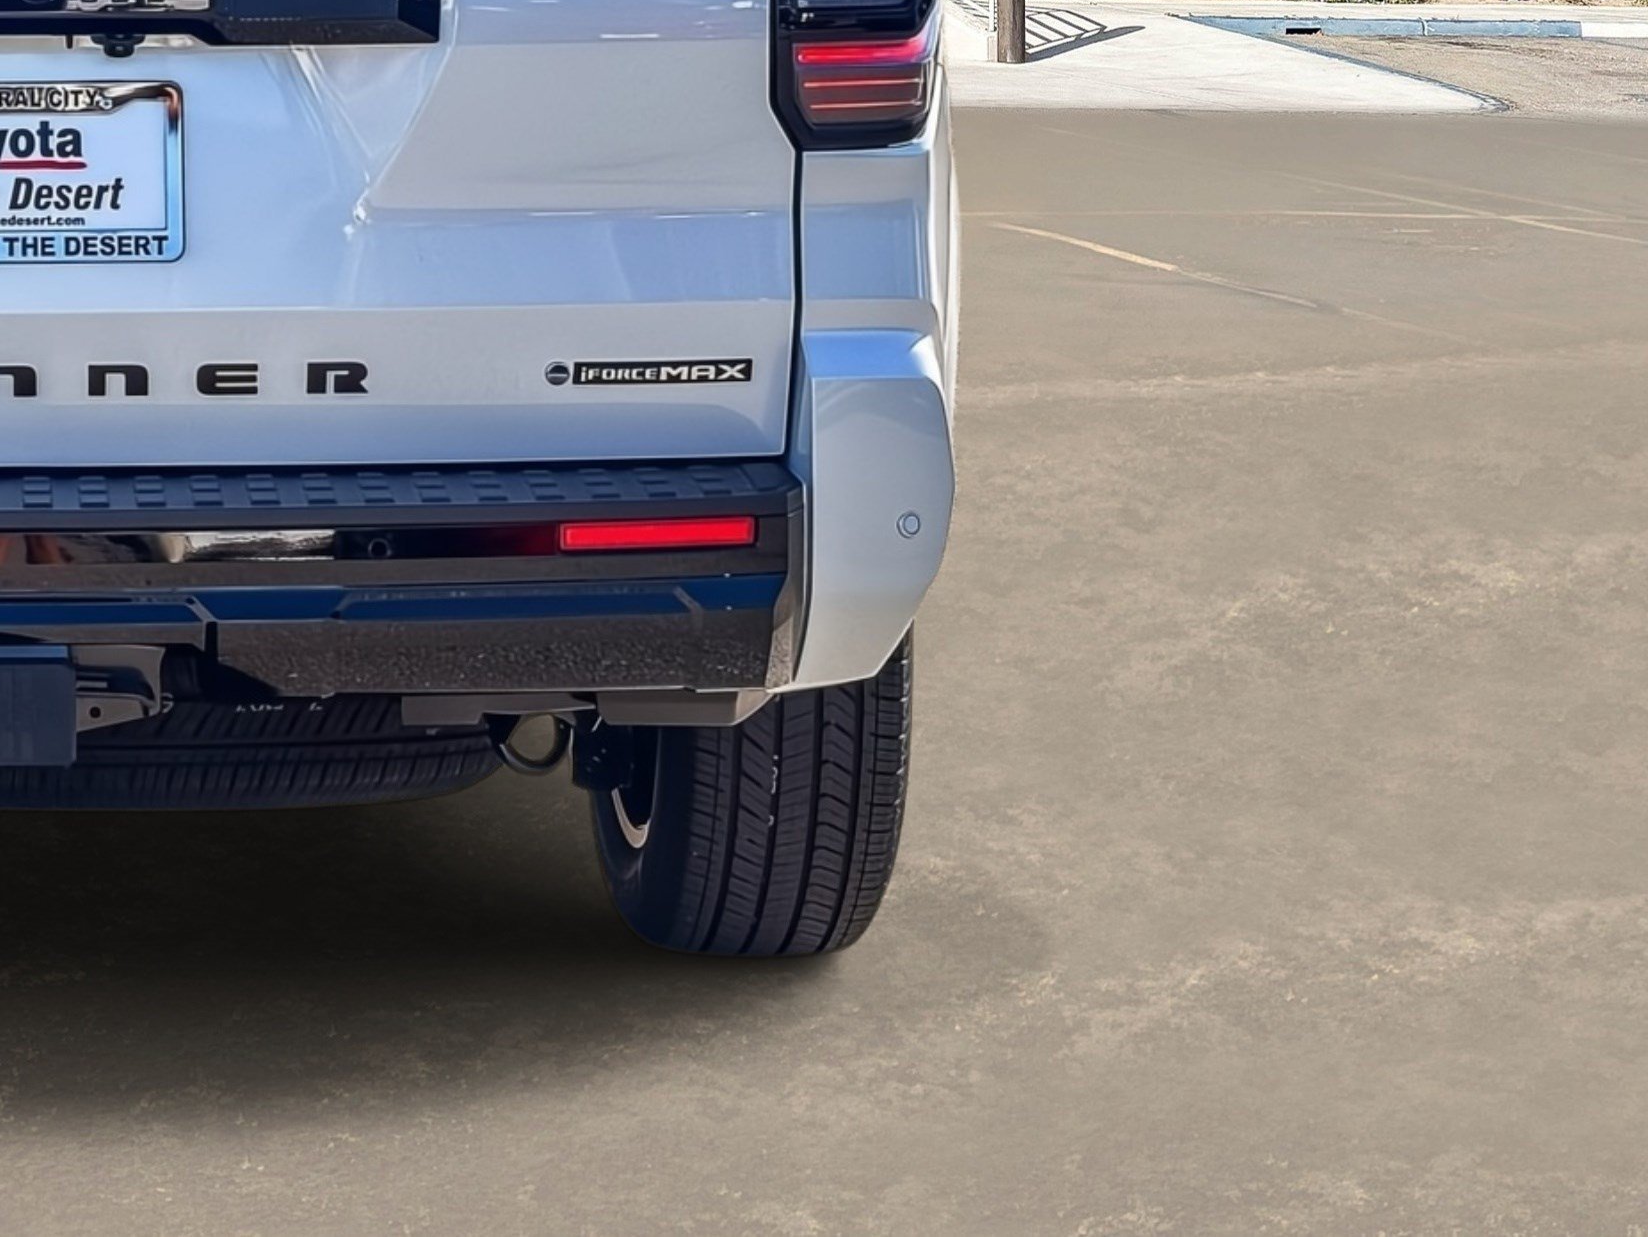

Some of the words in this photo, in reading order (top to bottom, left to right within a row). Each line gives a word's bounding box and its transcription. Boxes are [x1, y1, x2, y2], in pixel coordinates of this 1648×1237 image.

[46, 87, 100, 111] CITY
[8, 178, 124, 211] Desert
[2, 237, 56, 257] THE
[63, 236, 169, 257] DESERT
